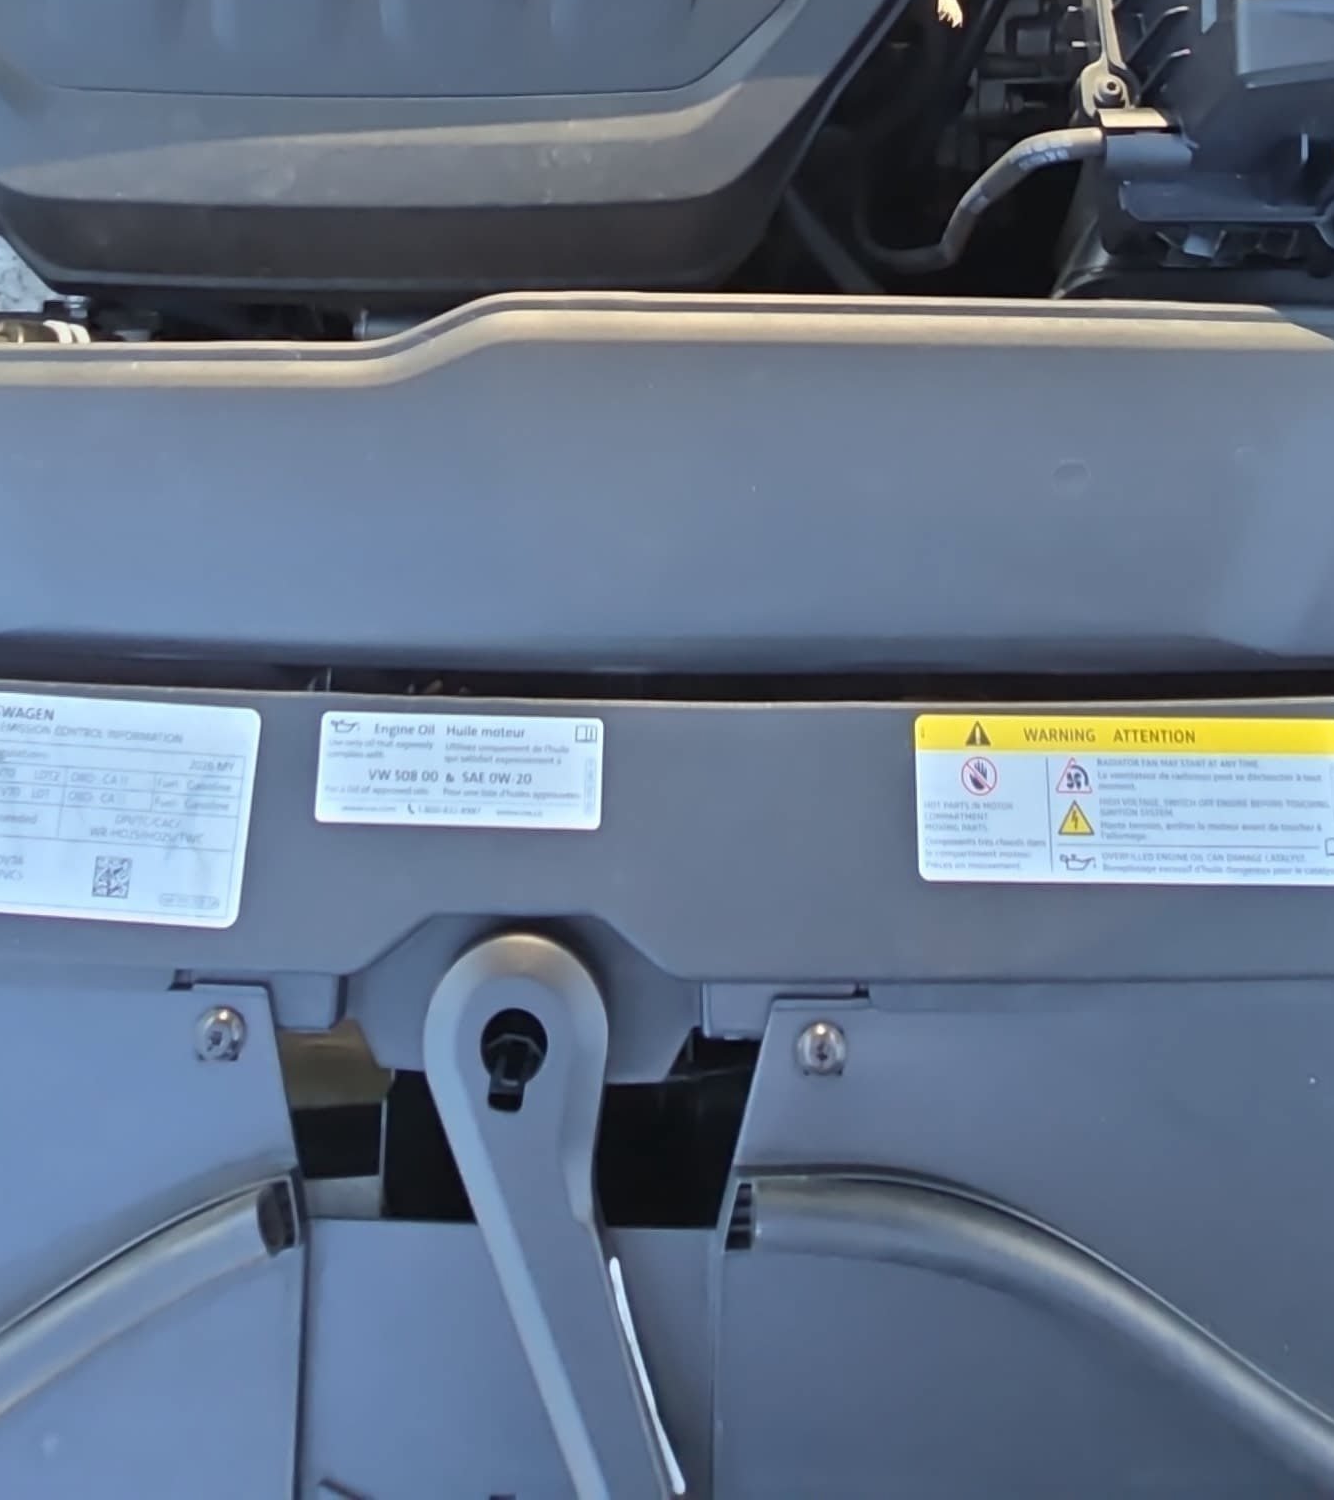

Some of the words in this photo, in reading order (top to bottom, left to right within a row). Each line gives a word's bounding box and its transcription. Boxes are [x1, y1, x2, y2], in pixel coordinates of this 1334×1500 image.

[374, 723, 415, 738] Engine
[417, 724, 435, 736] Oil
[446, 724, 478, 737] Huile
[481, 726, 525, 739] moteur
[1023, 727, 1096, 743] WARNING
[1113, 728, 1197, 744] ATTENTION
[368, 768, 392, 781] VW
[395, 769, 418, 782] 508
[421, 770, 439, 782] 00
[462, 771, 485, 784] SAE
